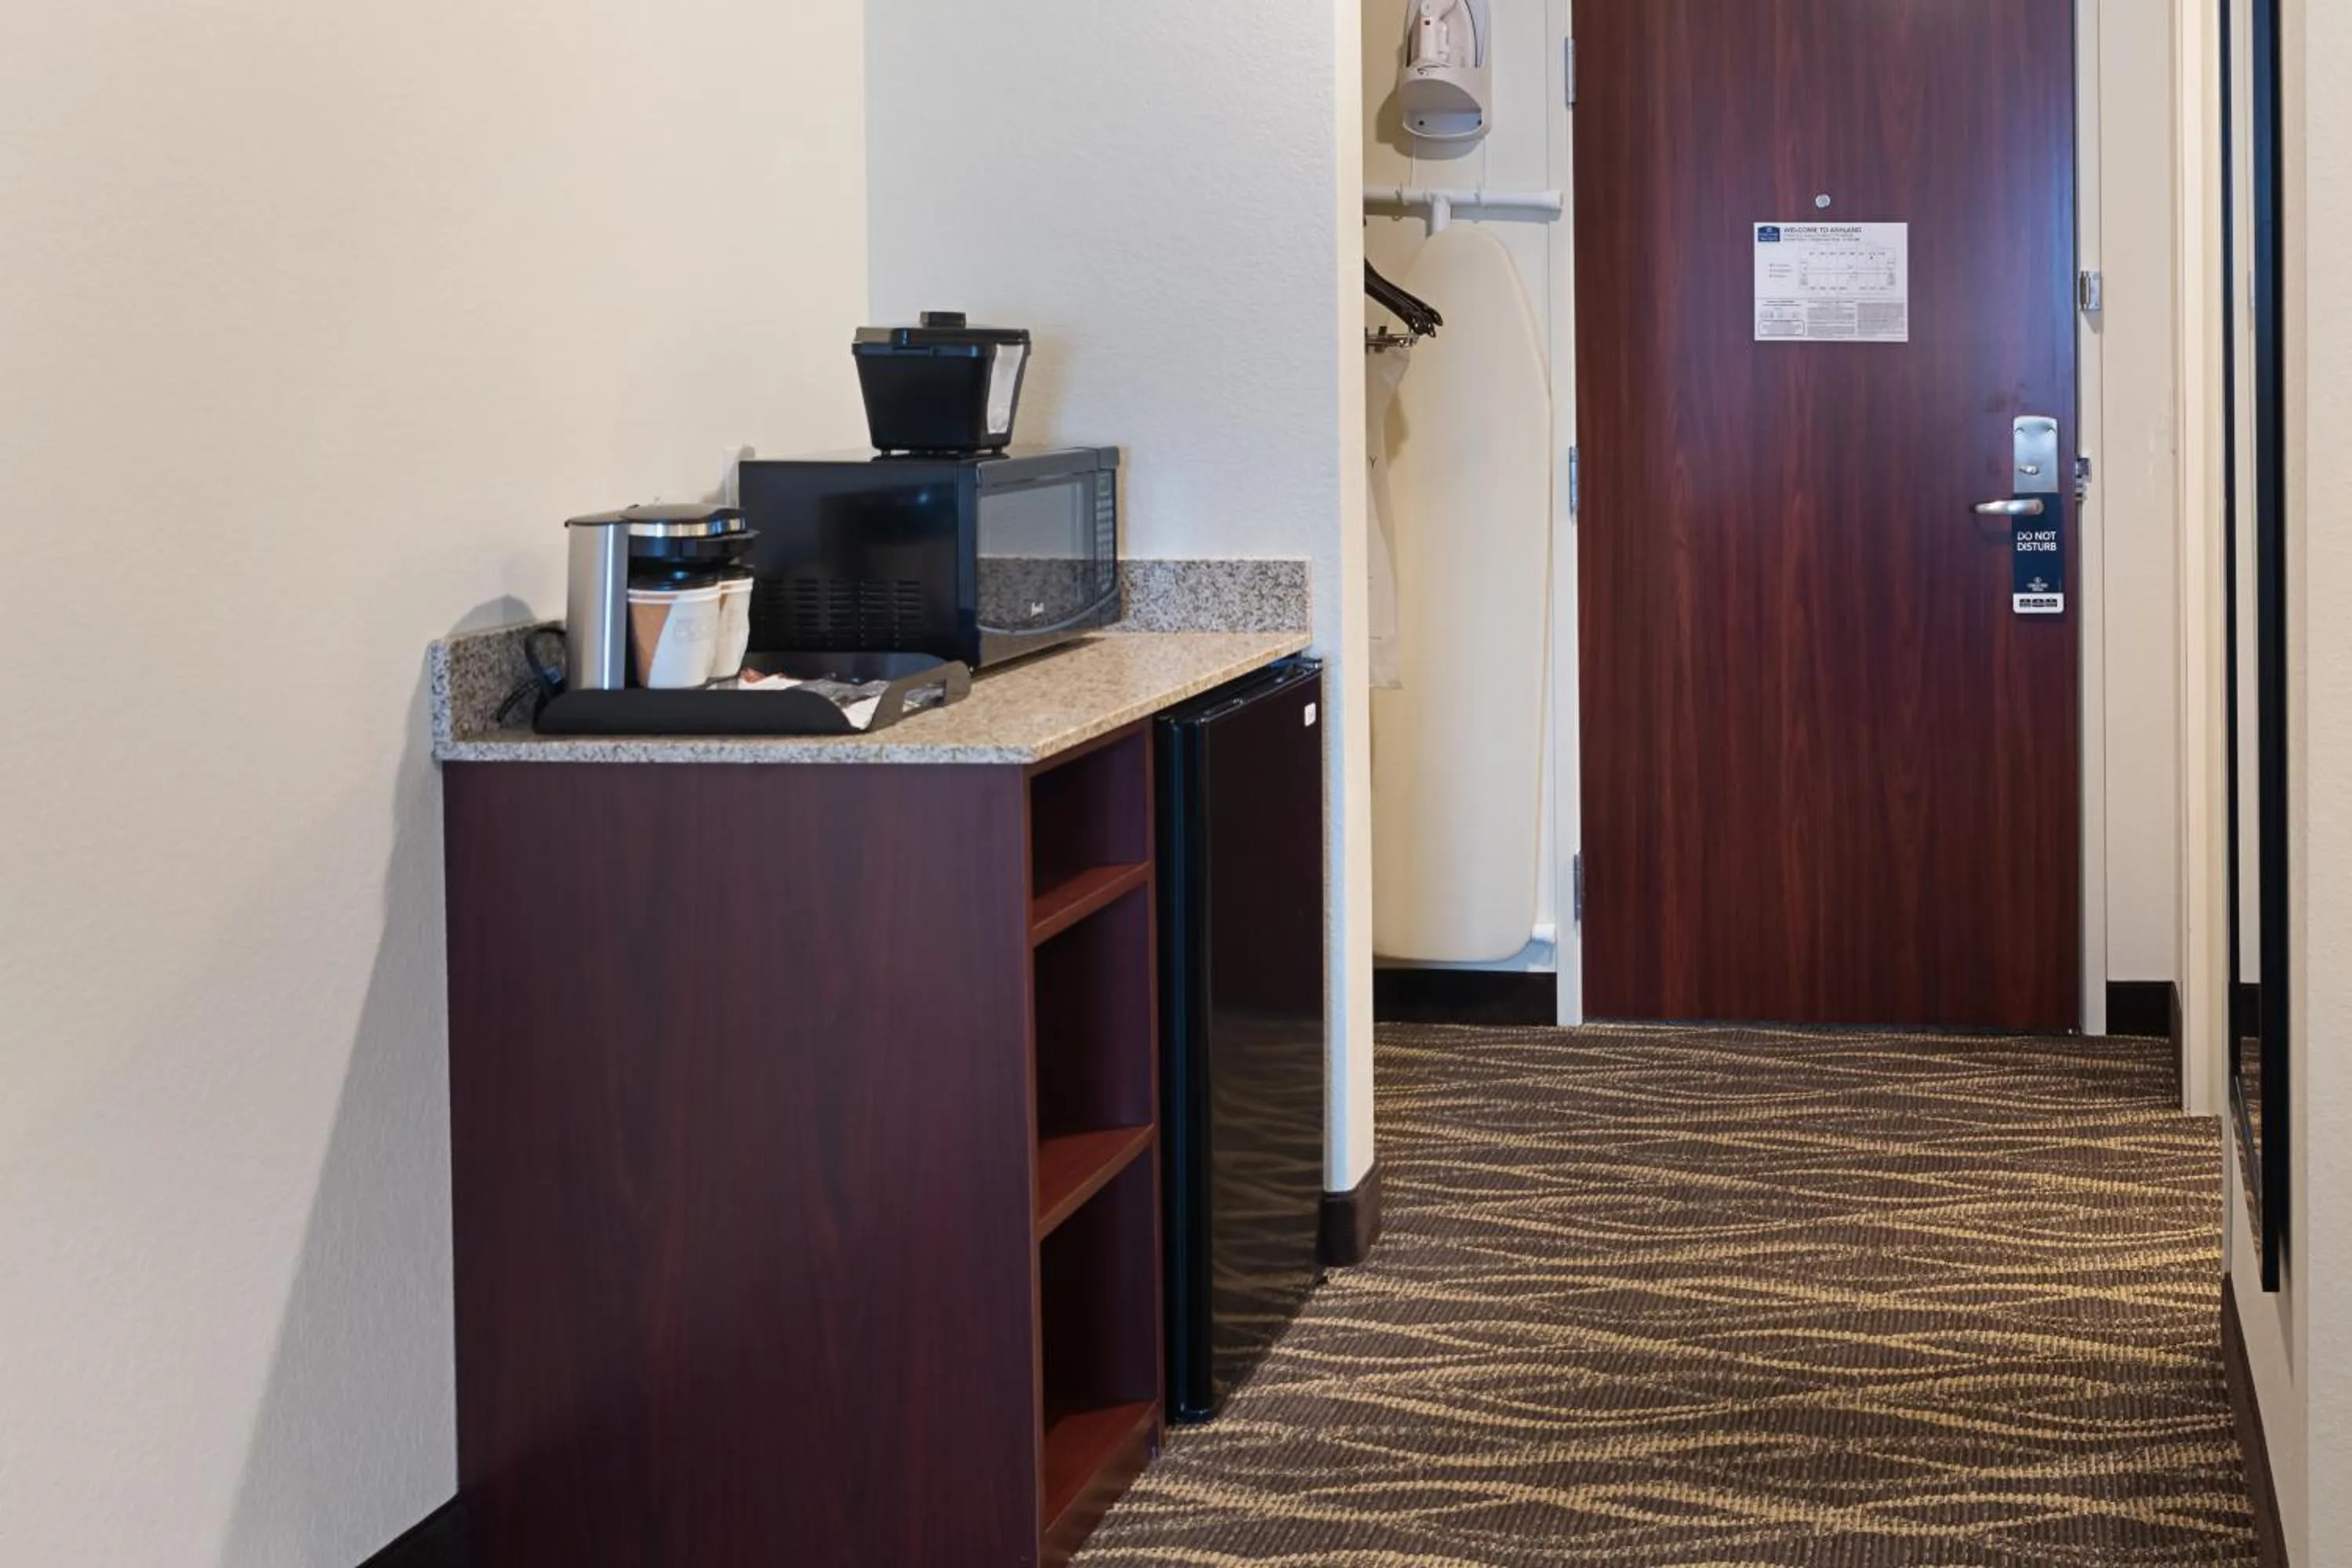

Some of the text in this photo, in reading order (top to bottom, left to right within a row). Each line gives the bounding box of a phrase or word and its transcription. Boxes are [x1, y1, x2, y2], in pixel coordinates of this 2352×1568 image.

[2017, 532, 2056, 540] DO NOT
[2017, 542, 2057, 551] DISTURB
